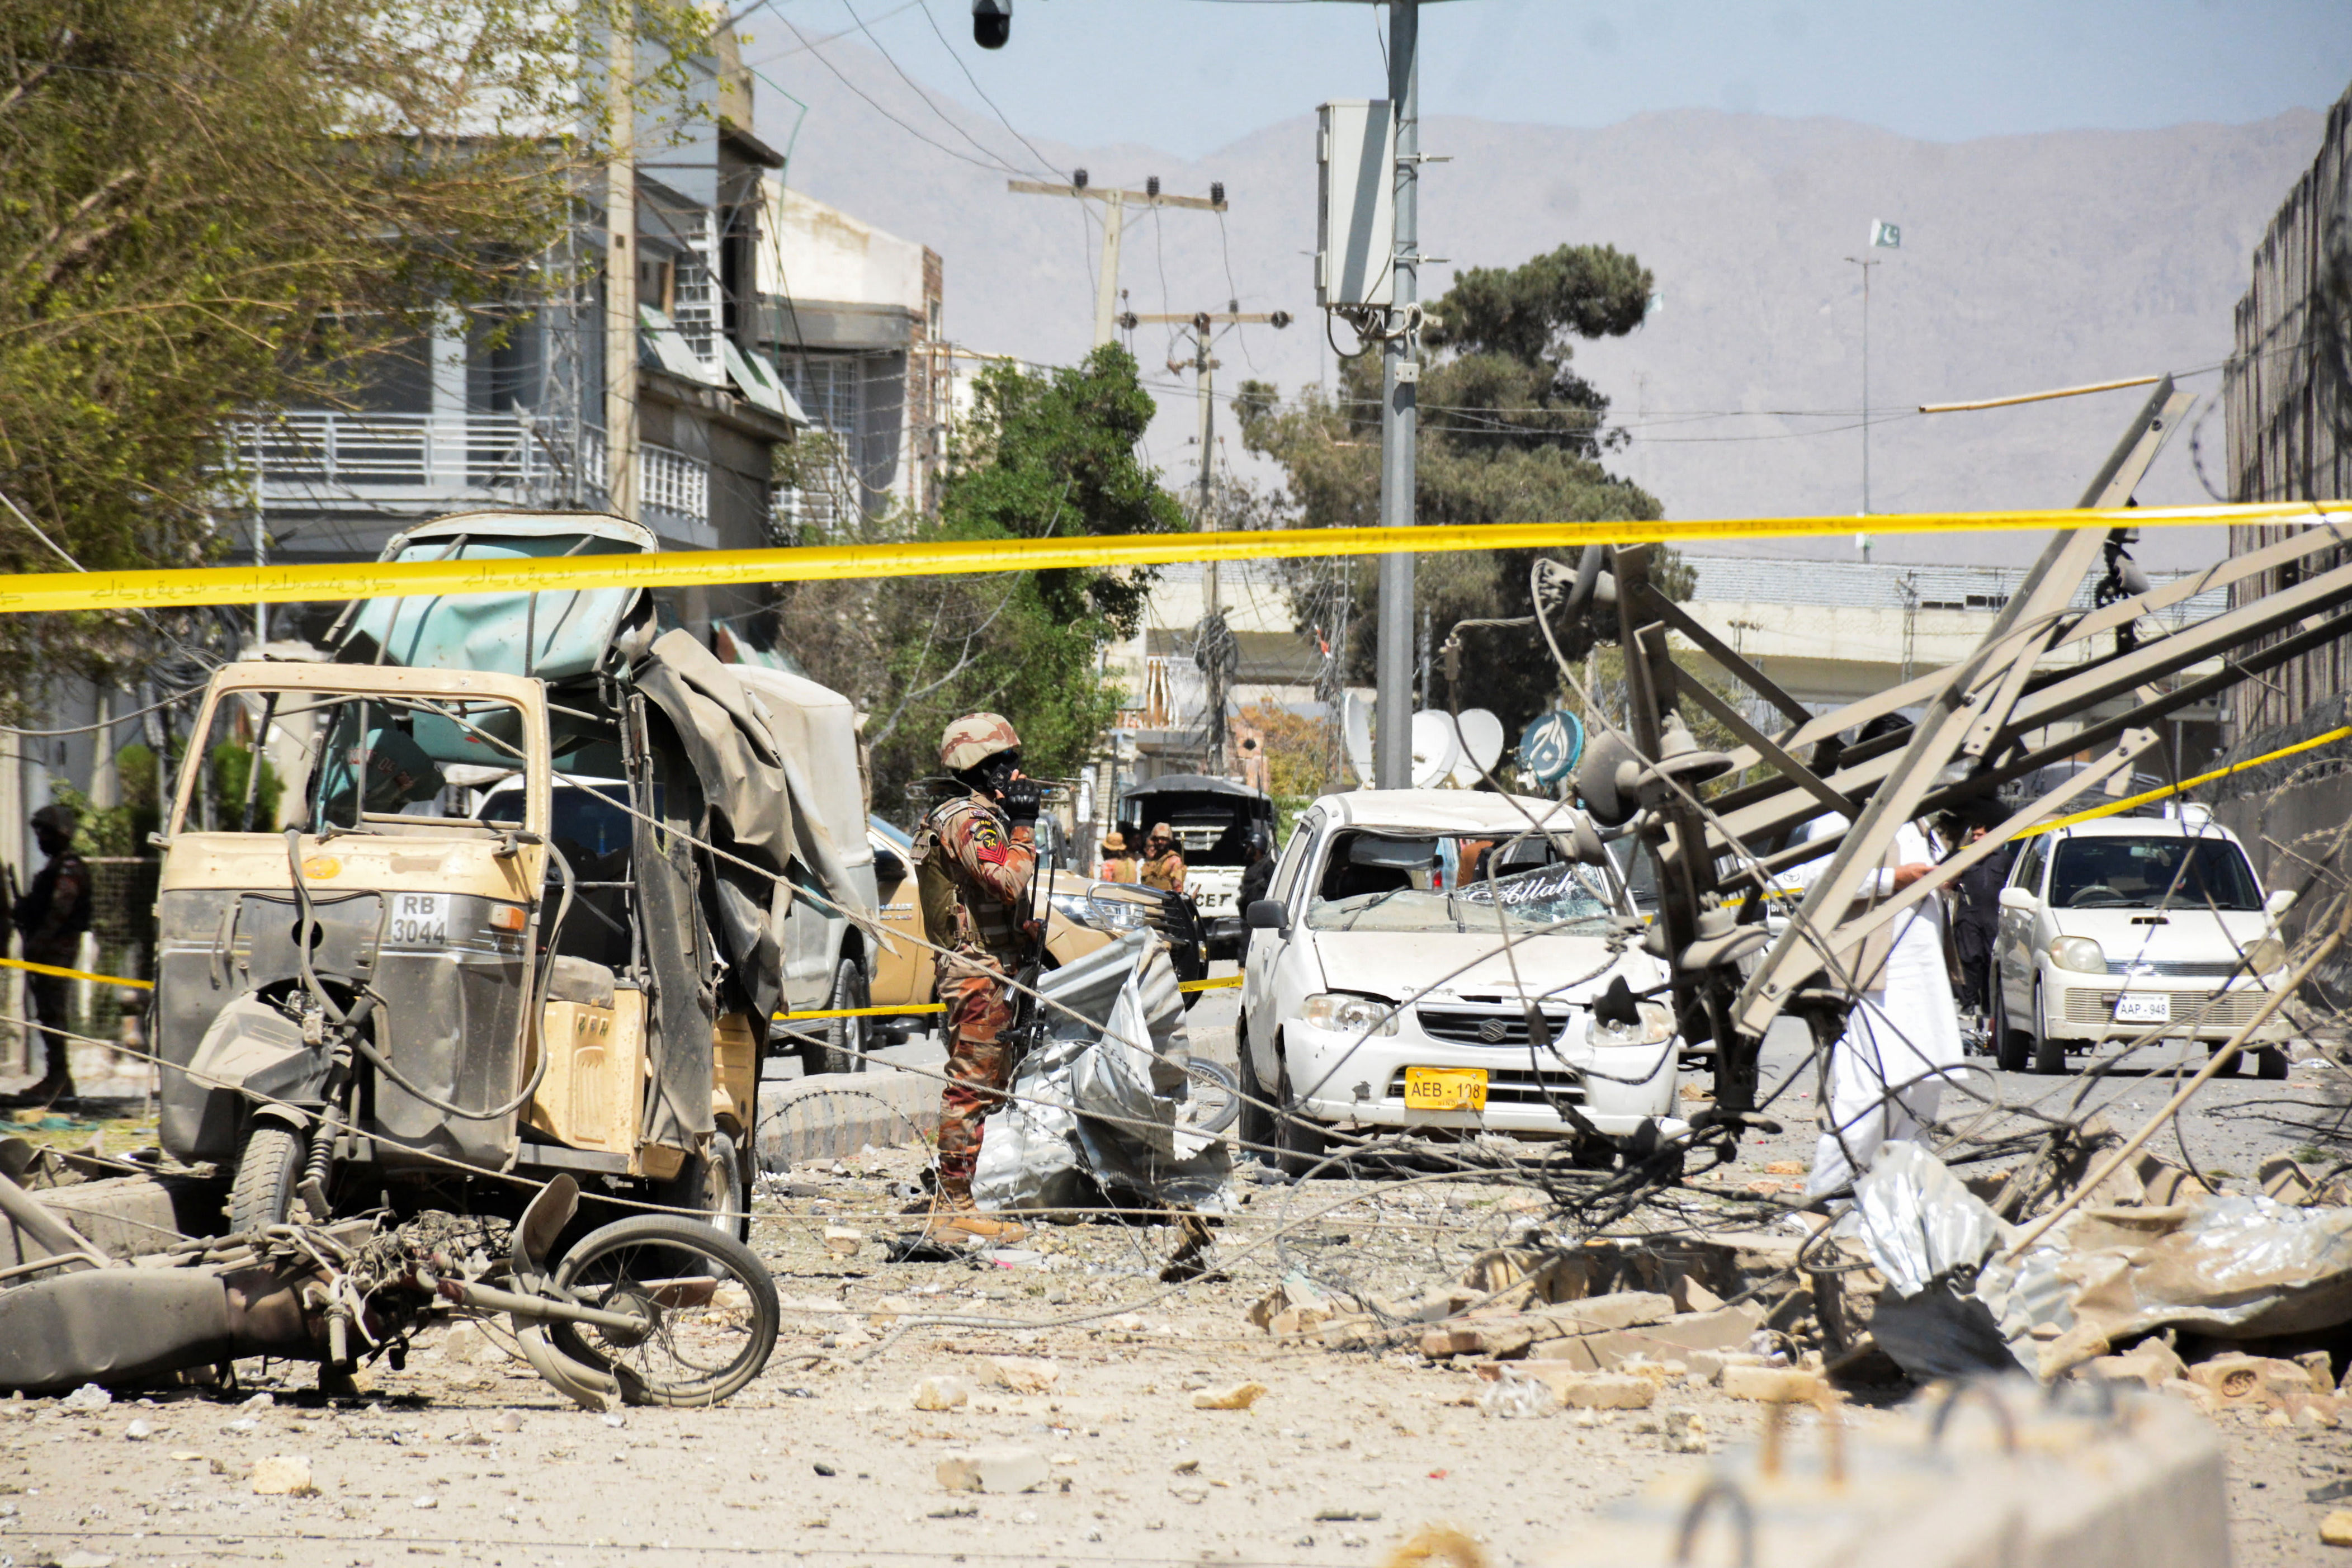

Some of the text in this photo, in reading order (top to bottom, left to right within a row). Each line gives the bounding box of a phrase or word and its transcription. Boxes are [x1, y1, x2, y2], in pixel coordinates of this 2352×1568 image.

[403, 896, 434, 914] RB
[393, 919, 445, 945] 3044
[2120, 1004, 2141, 1014] AAP
[2150, 1004, 2166, 1015] 948
[1411, 1082, 1442, 1097] AEB
[1457, 1083, 1480, 1099] 108
